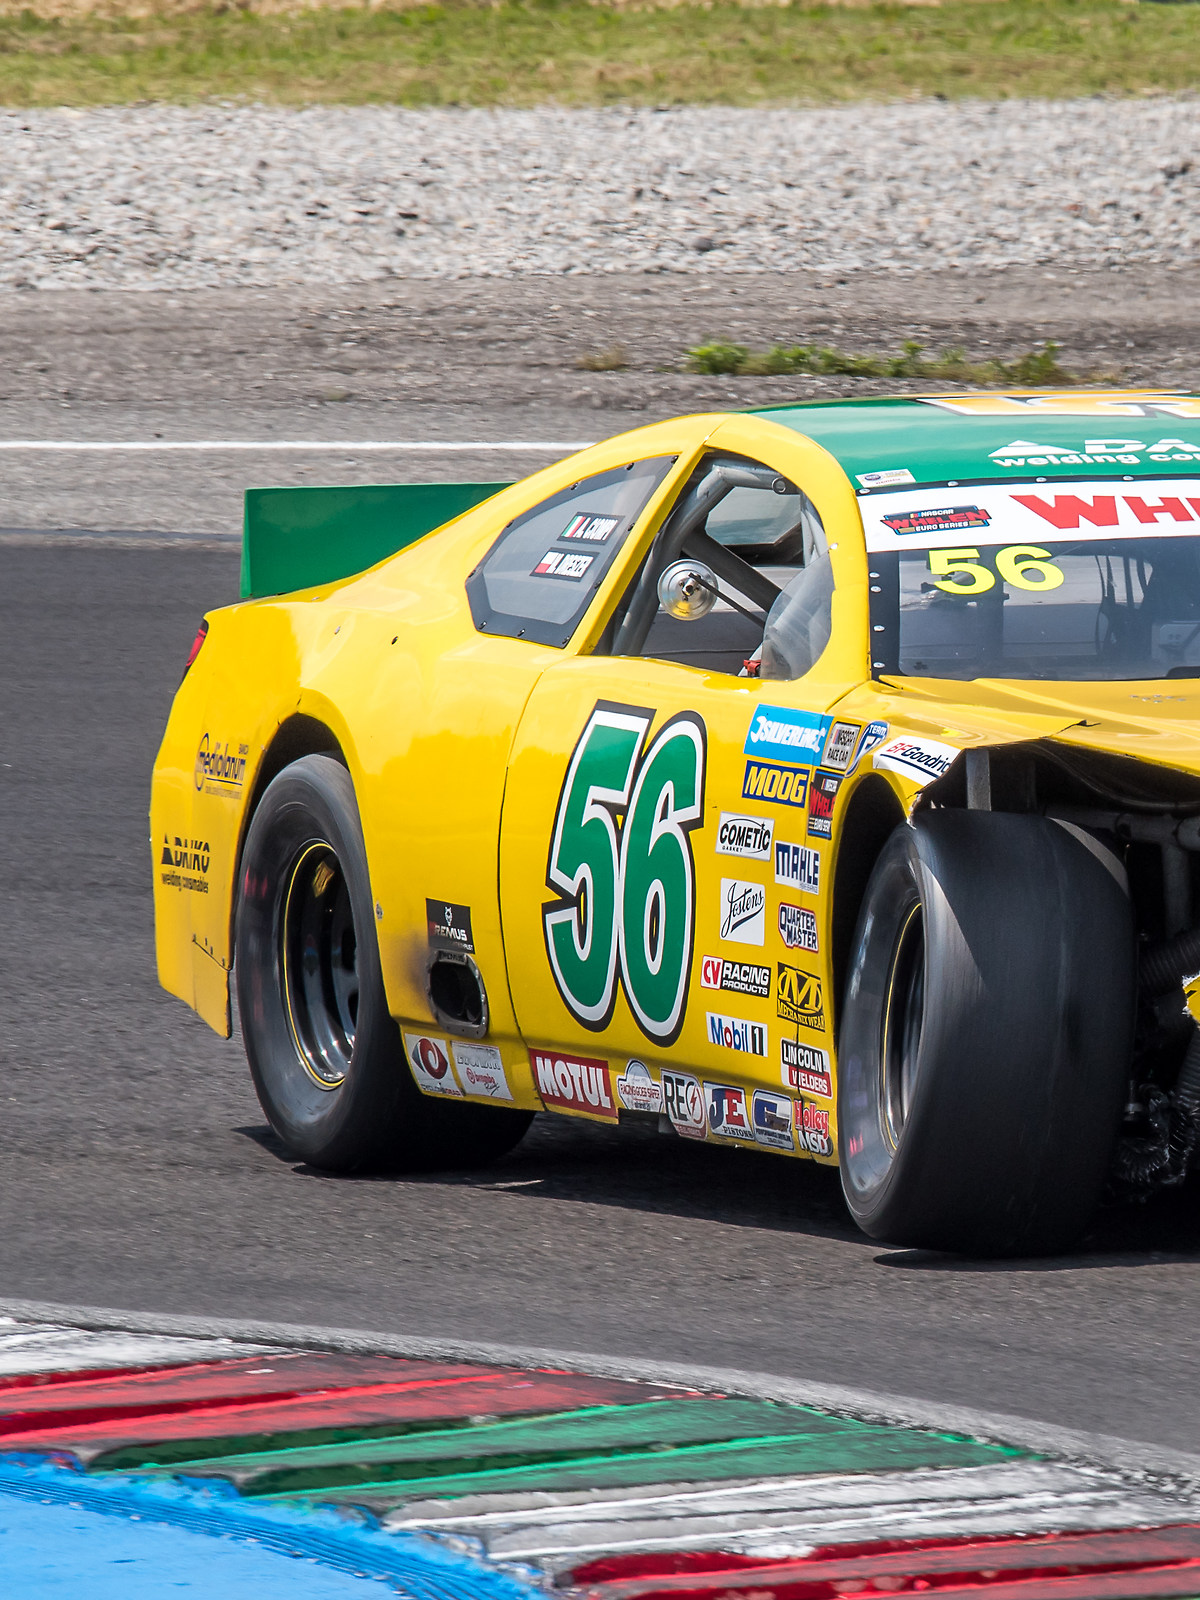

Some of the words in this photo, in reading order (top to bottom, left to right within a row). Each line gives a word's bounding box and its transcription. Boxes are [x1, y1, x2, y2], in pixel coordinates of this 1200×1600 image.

[993, 450, 1140, 467] welding
[881, 509, 992, 529] WHELEN
[921, 509, 954, 517] NASCAR
[915, 524, 938, 532] EURO
[939, 521, 969, 529] SERIES
[929, 545, 1065, 595] 56
[868, 724, 887, 737] TEAM
[827, 747, 839, 760] RACE
[838, 749, 849, 763] CAR
[744, 767, 808, 804] MOOG
[720, 823, 771, 851] COMETIC
[543, 700, 706, 1046] 56
[776, 843, 819, 886] MAHLE
[721, 882, 765, 938] Jostens
[780, 906, 816, 932] QUARTER
[434, 925, 468, 941] REMUS
[786, 929, 818, 949] MASTER
[704, 960, 722, 985] CV
[722, 962, 770, 986] RACING
[722, 979, 768, 996] PRODUCTS
[777, 999, 808, 1026] MECHANIX
[808, 1014, 826, 1030] WEAR
[710, 1015, 748, 1052] Mobil
[783, 1043, 824, 1072] LINCOLN
[535, 1056, 612, 1109] MOTUL
[791, 1068, 828, 1094] WELDERS
[709, 1087, 746, 1129] JE
[794, 1100, 829, 1139] Holley
[722, 1125, 754, 1139] PISTONS
[798, 1130, 830, 1155] MSD
